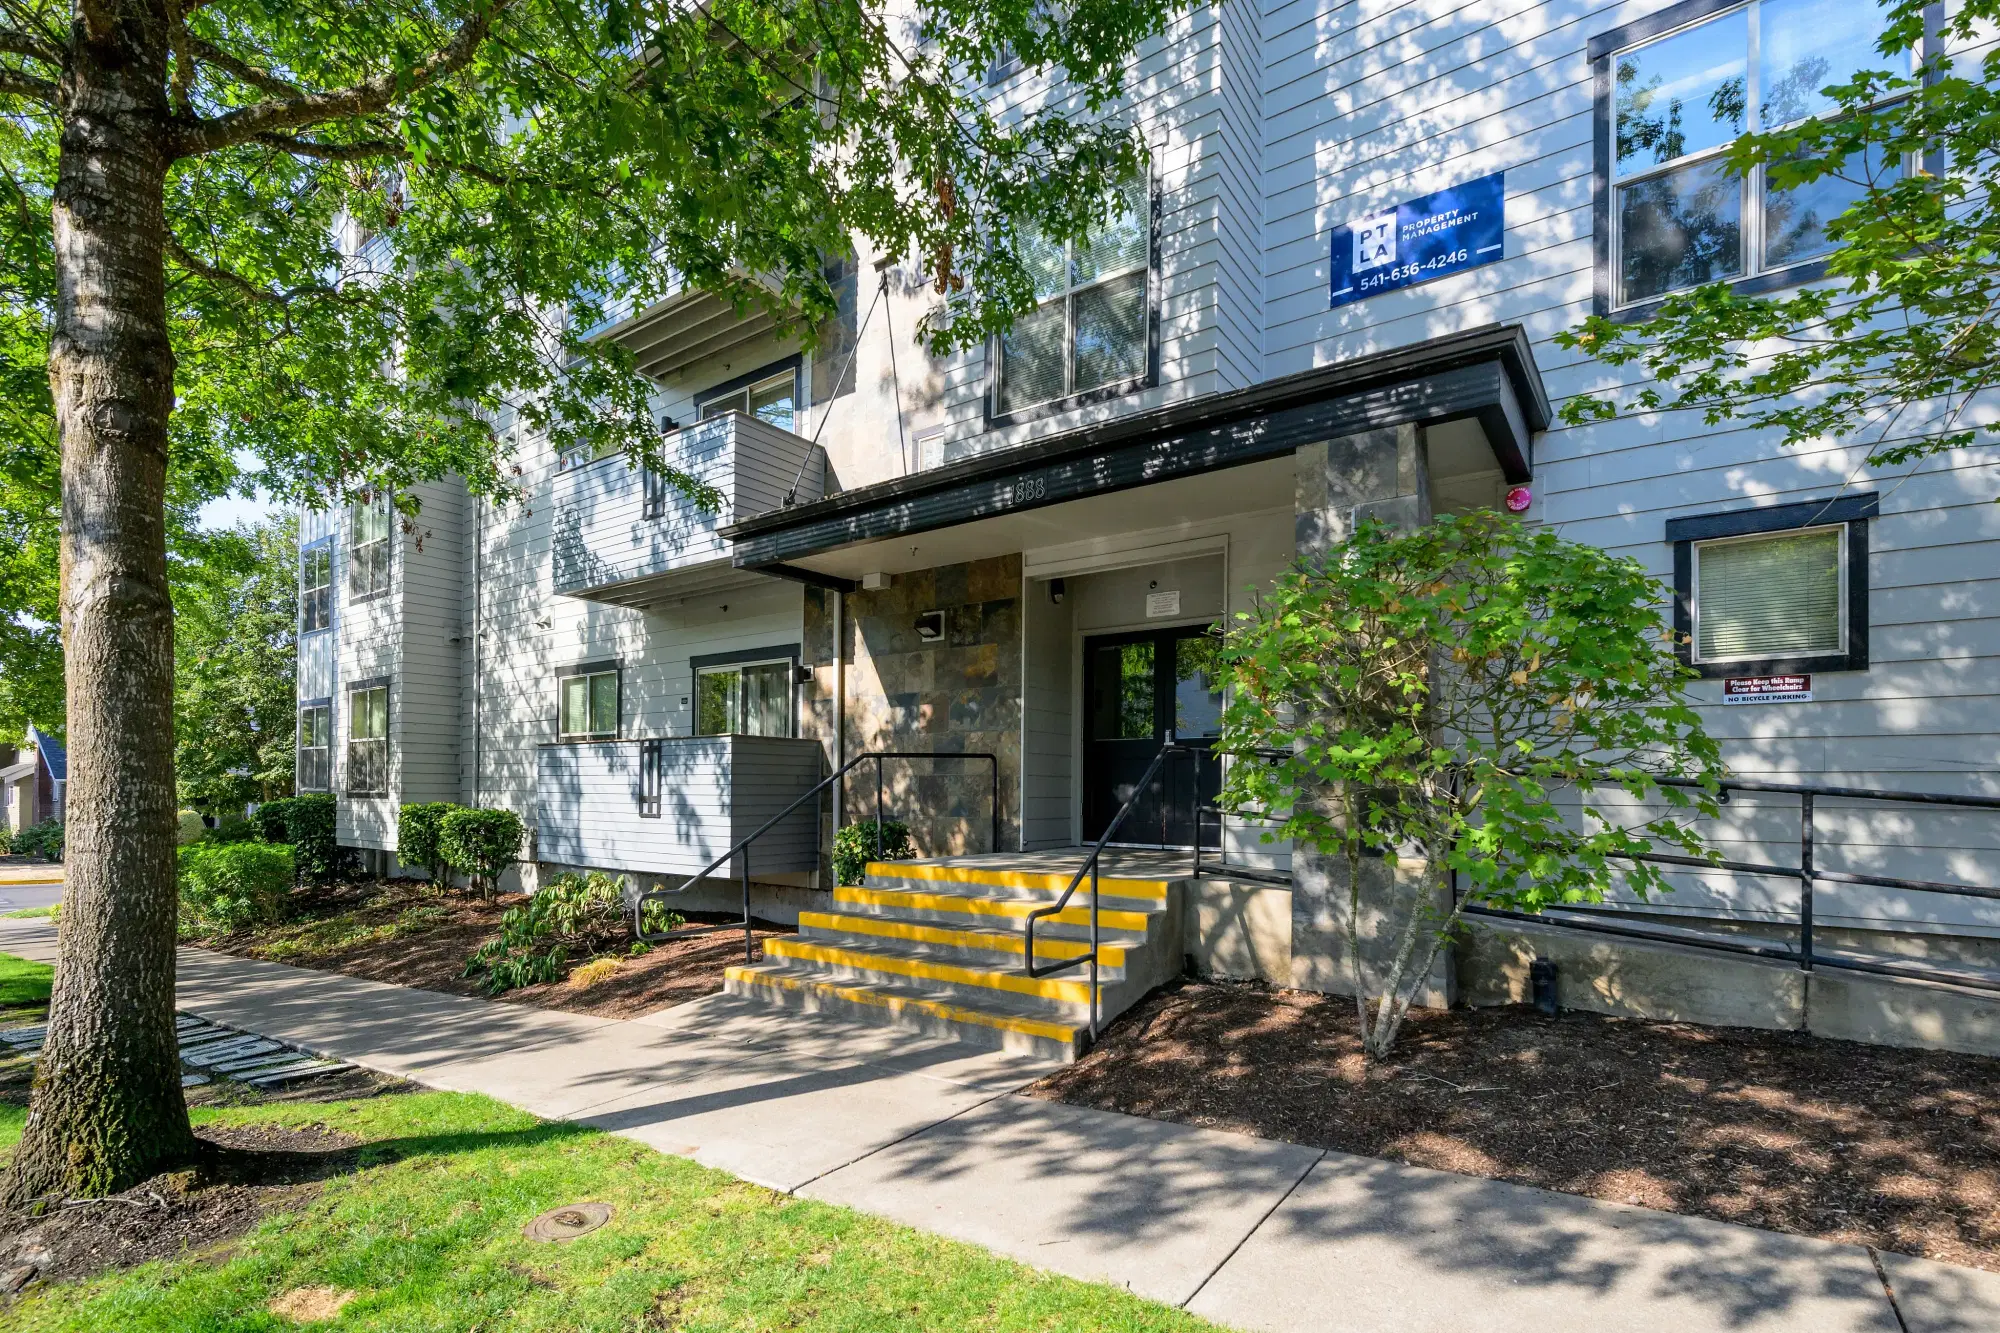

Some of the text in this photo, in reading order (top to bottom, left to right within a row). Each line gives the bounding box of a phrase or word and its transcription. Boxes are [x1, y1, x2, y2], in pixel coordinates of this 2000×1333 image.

[1403, 209, 1459, 233] PROPERTY
[1403, 212, 1479, 241] MANAGEMENT
[1360, 249, 1468, 291] 541-636-4246
[1009, 477, 1046, 505] 1888
[1761, 684, 1803, 692] Wheelchairs
